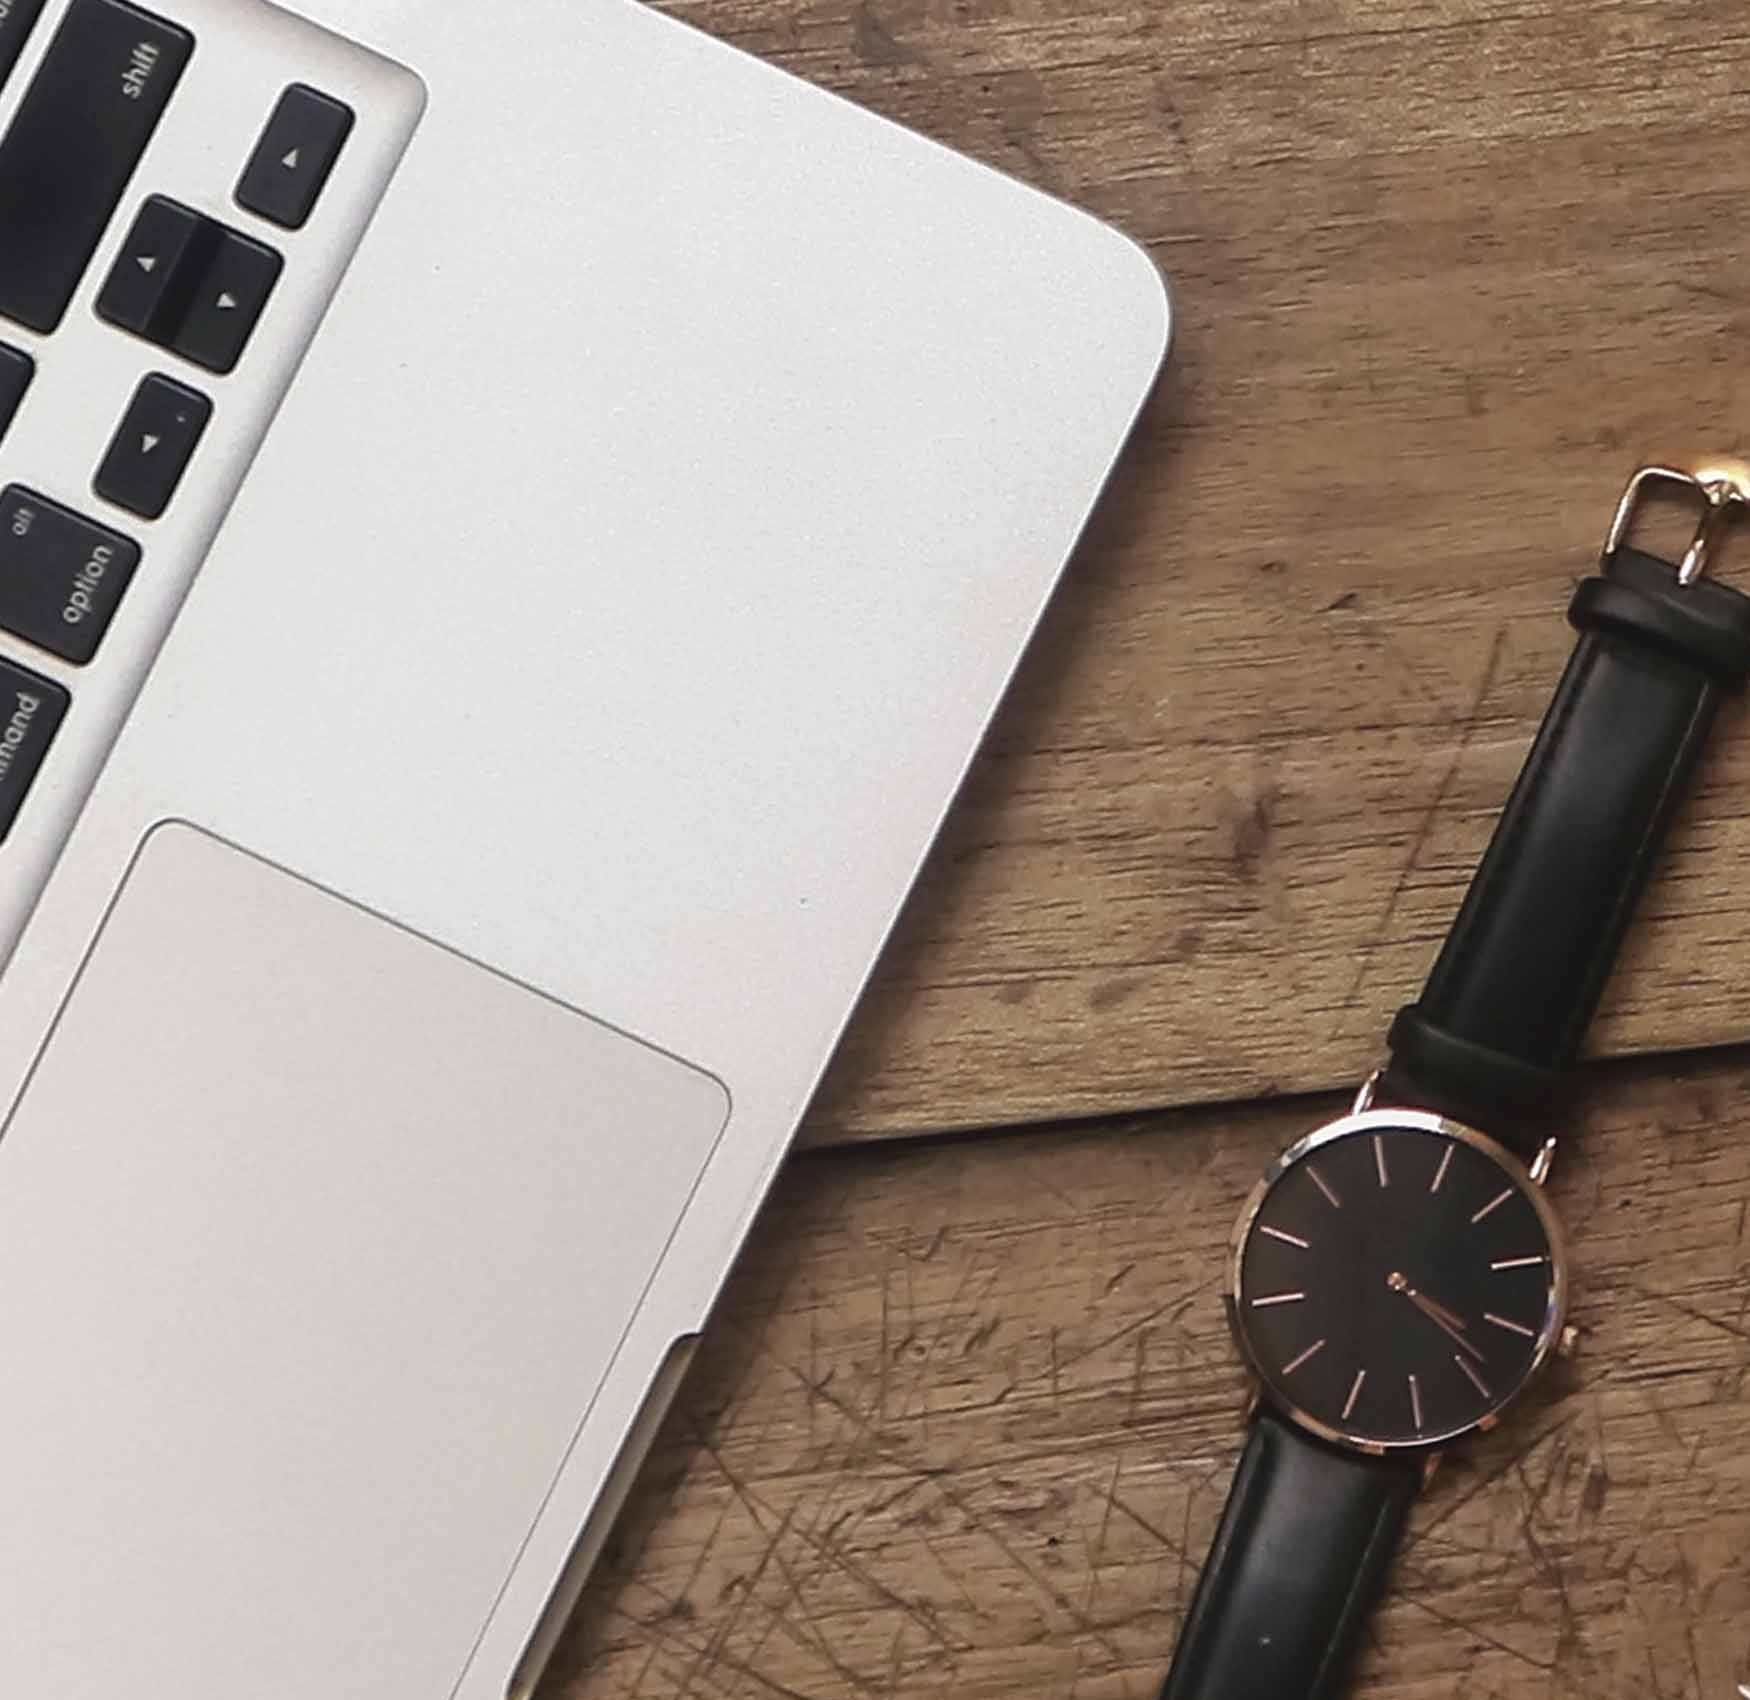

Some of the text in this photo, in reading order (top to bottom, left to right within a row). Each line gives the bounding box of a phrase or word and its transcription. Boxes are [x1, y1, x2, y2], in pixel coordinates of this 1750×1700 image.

[122, 42, 159, 99] shift
[12, 508, 34, 535] alt
[63, 545, 112, 623] option
